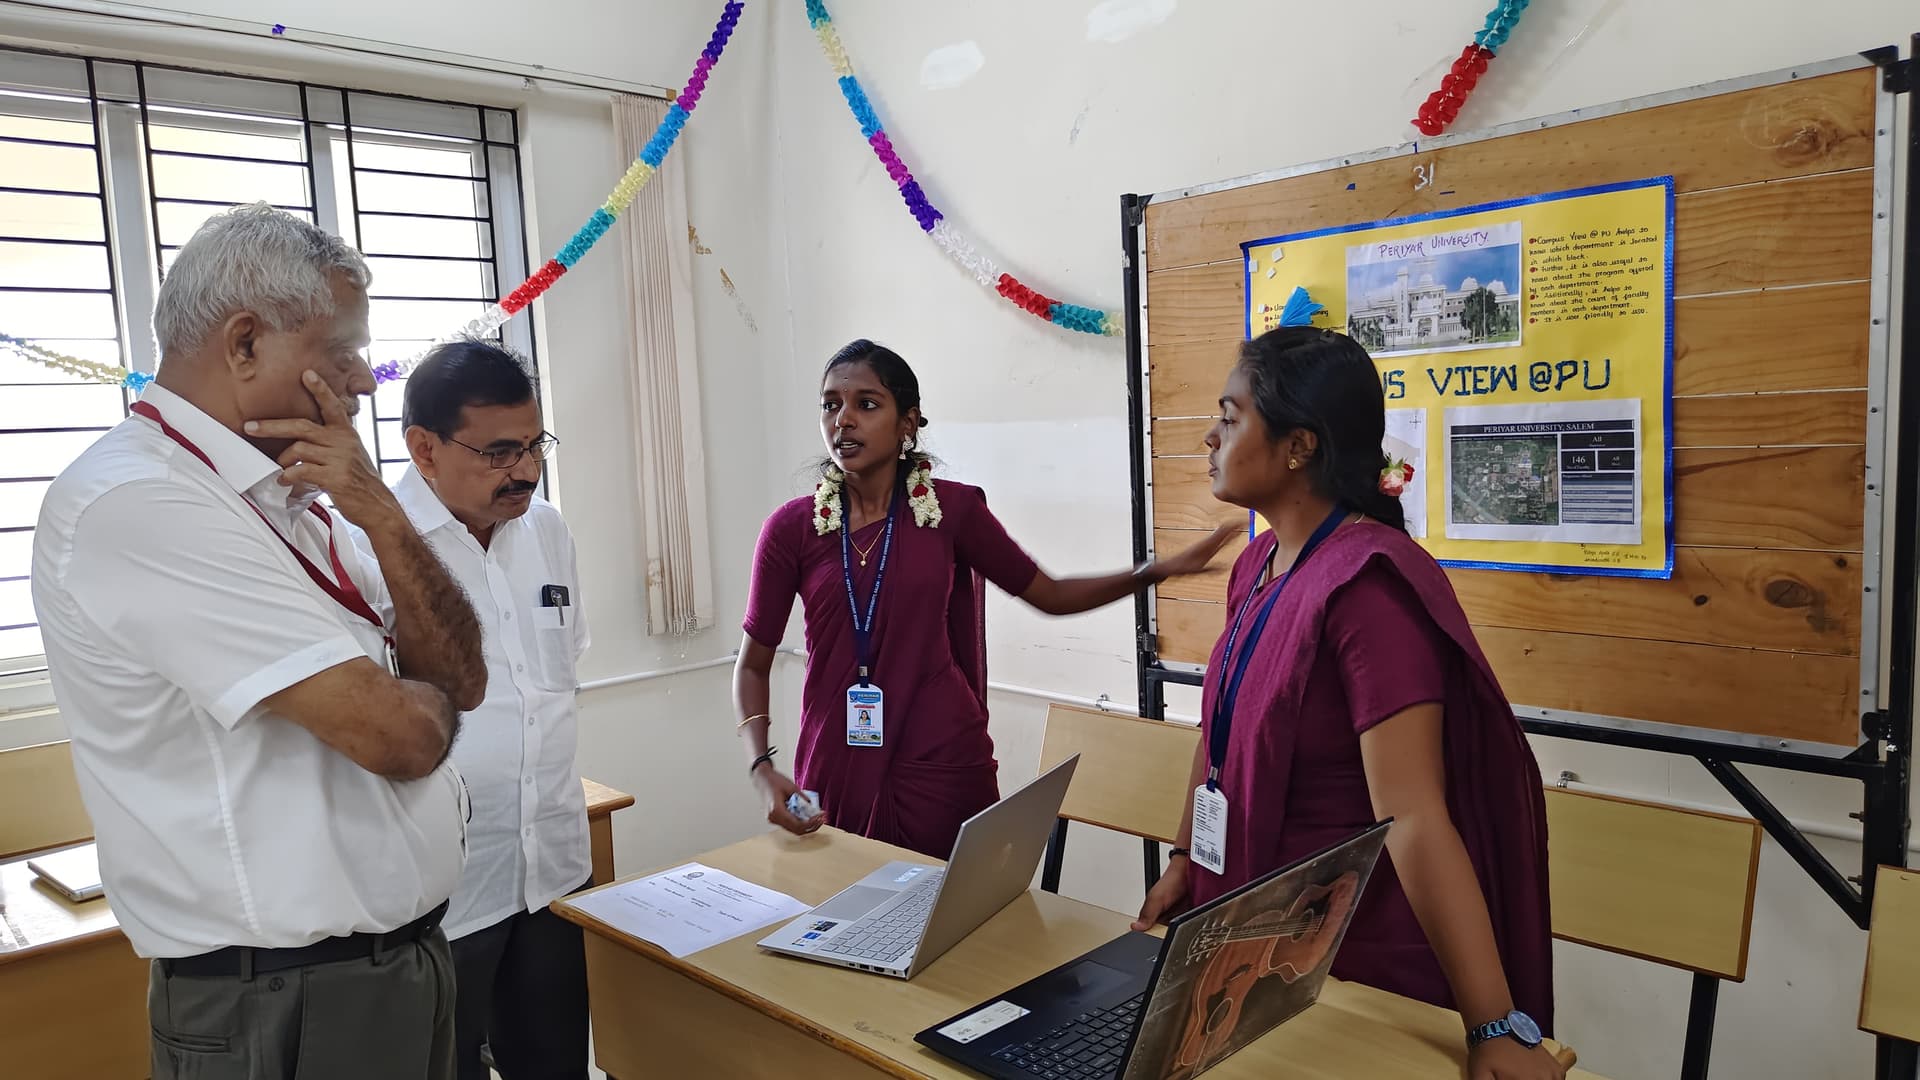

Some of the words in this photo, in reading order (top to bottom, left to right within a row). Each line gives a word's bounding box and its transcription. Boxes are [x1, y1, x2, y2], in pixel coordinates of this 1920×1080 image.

[1413, 161, 1435, 192] 31
[1601, 229, 1611, 237] PU
[1379, 242, 1426, 258] PERIYAR
[1549, 245, 1570, 253] which
[1572, 241, 1615, 251] department
[1592, 260, 1608, 268] also
[1426, 364, 1518, 396] VIEW
[1483, 424, 1516, 433] PERIYAR
[1565, 422, 1595, 431] SALEM
[1572, 455, 1586, 464] 146
